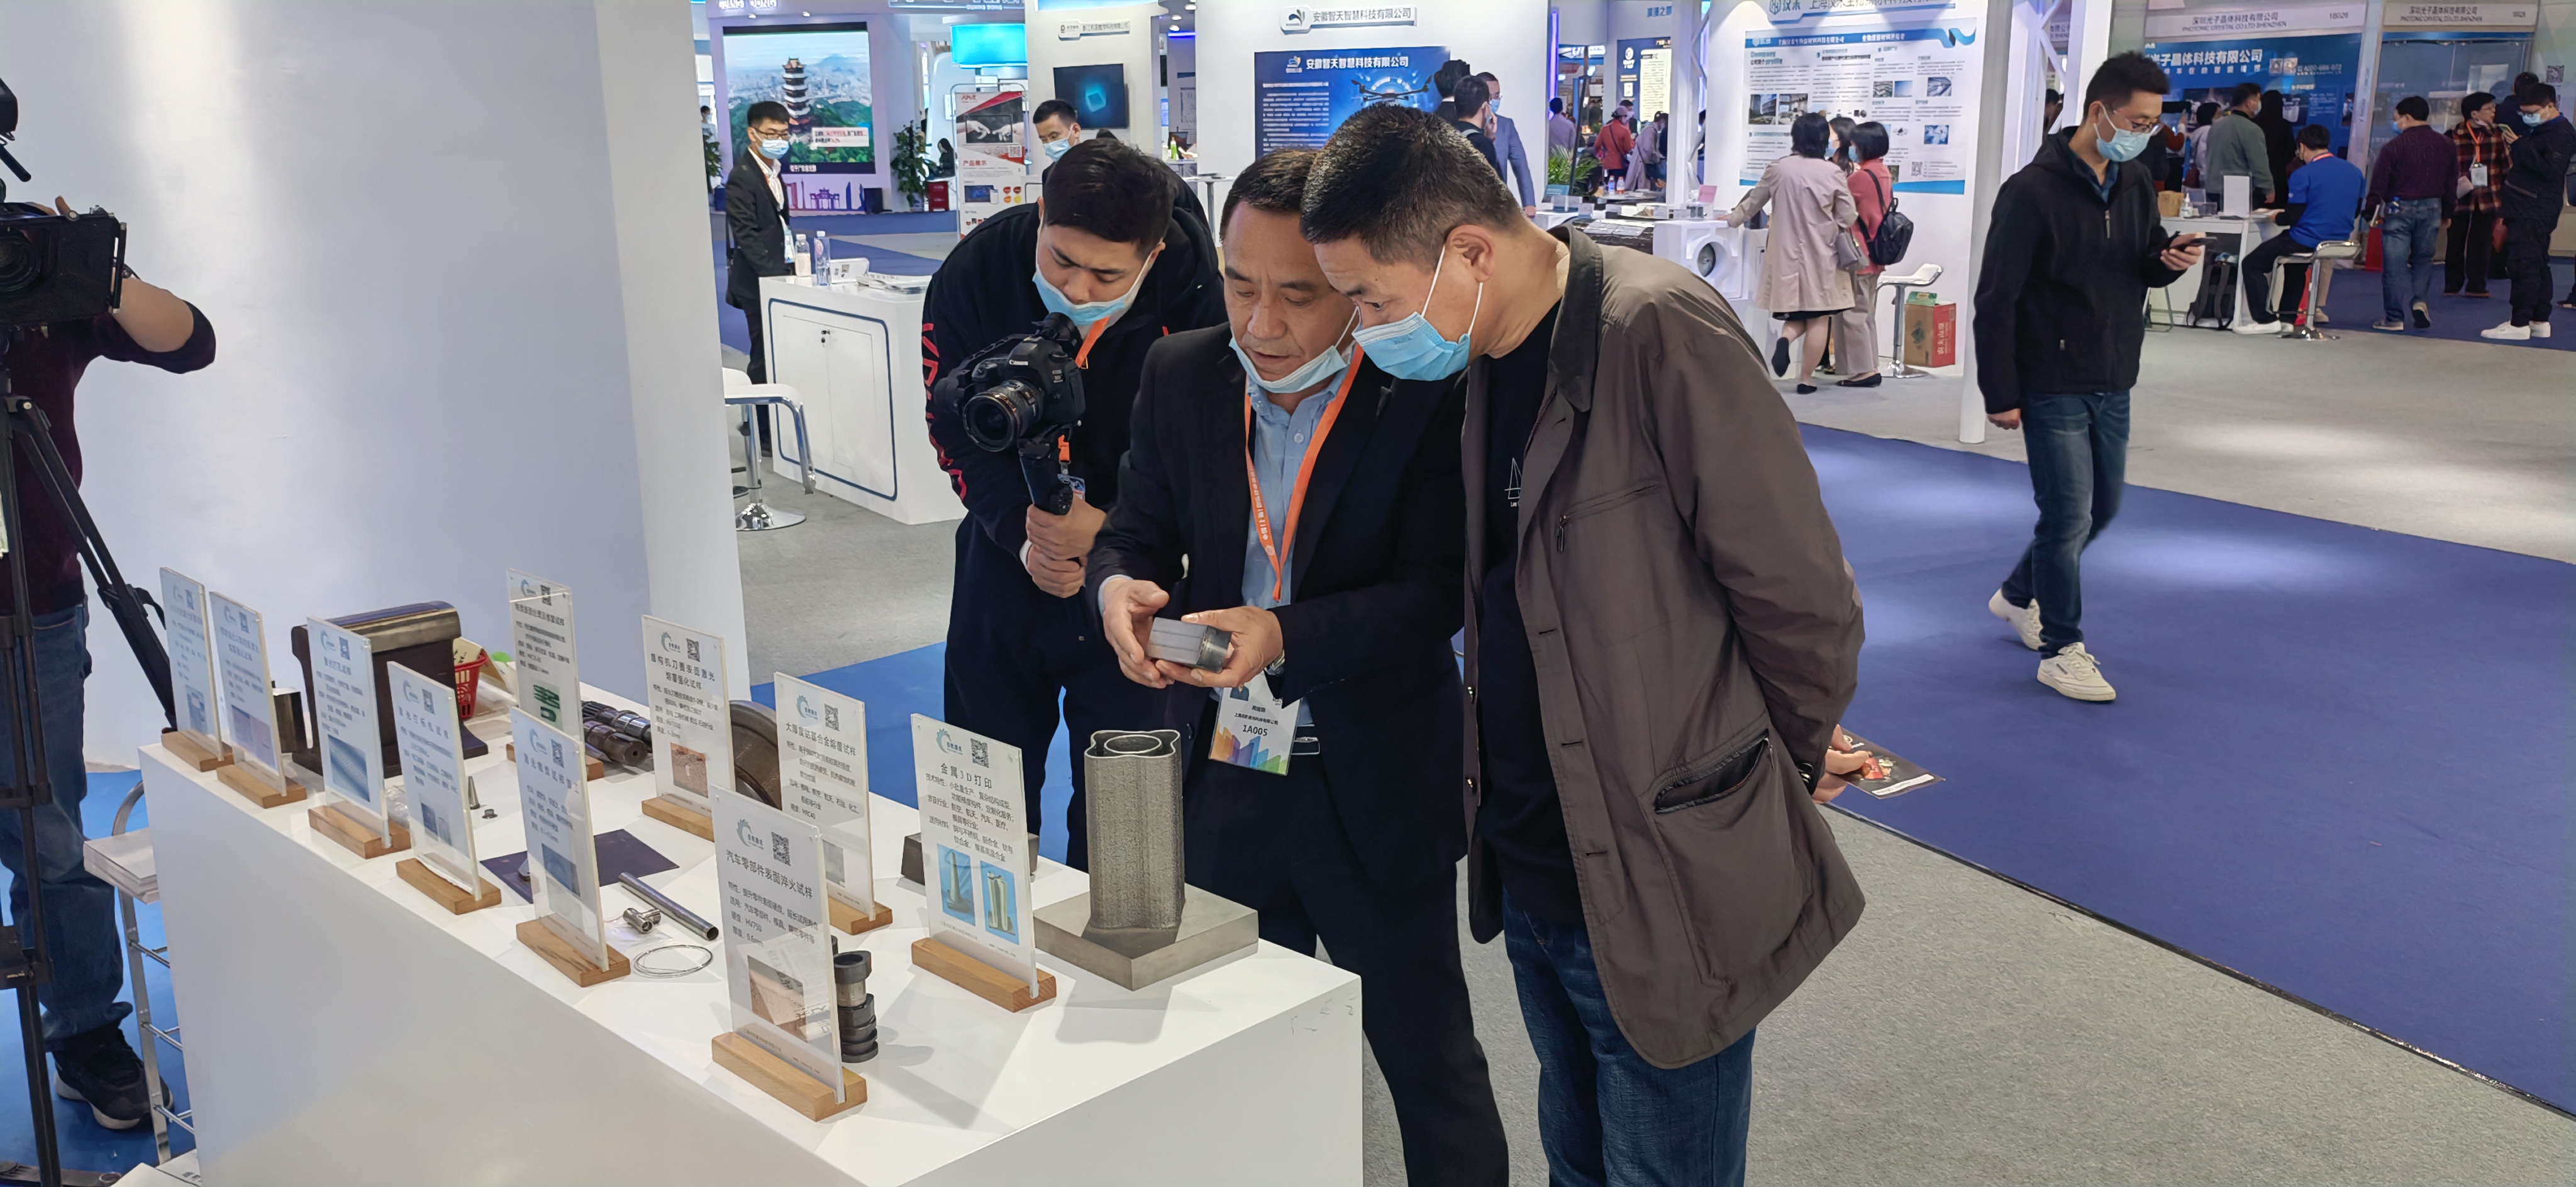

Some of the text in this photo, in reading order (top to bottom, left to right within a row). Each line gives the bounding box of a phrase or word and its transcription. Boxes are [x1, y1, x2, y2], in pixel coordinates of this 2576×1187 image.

[1313, 8, 1411, 22] 安徽智天智慧科技有限公司
[2193, 13, 2278, 25] 深圳光子晶体科技有限公司
[1306, 56, 1409, 69] 安徽智天智慧科技有限公司
[1243, 724, 1268, 736] 1A005
[941, 763, 992, 789] 金属3D打印
[726, 849, 814, 900] 汽车零部件表面淬火试样
